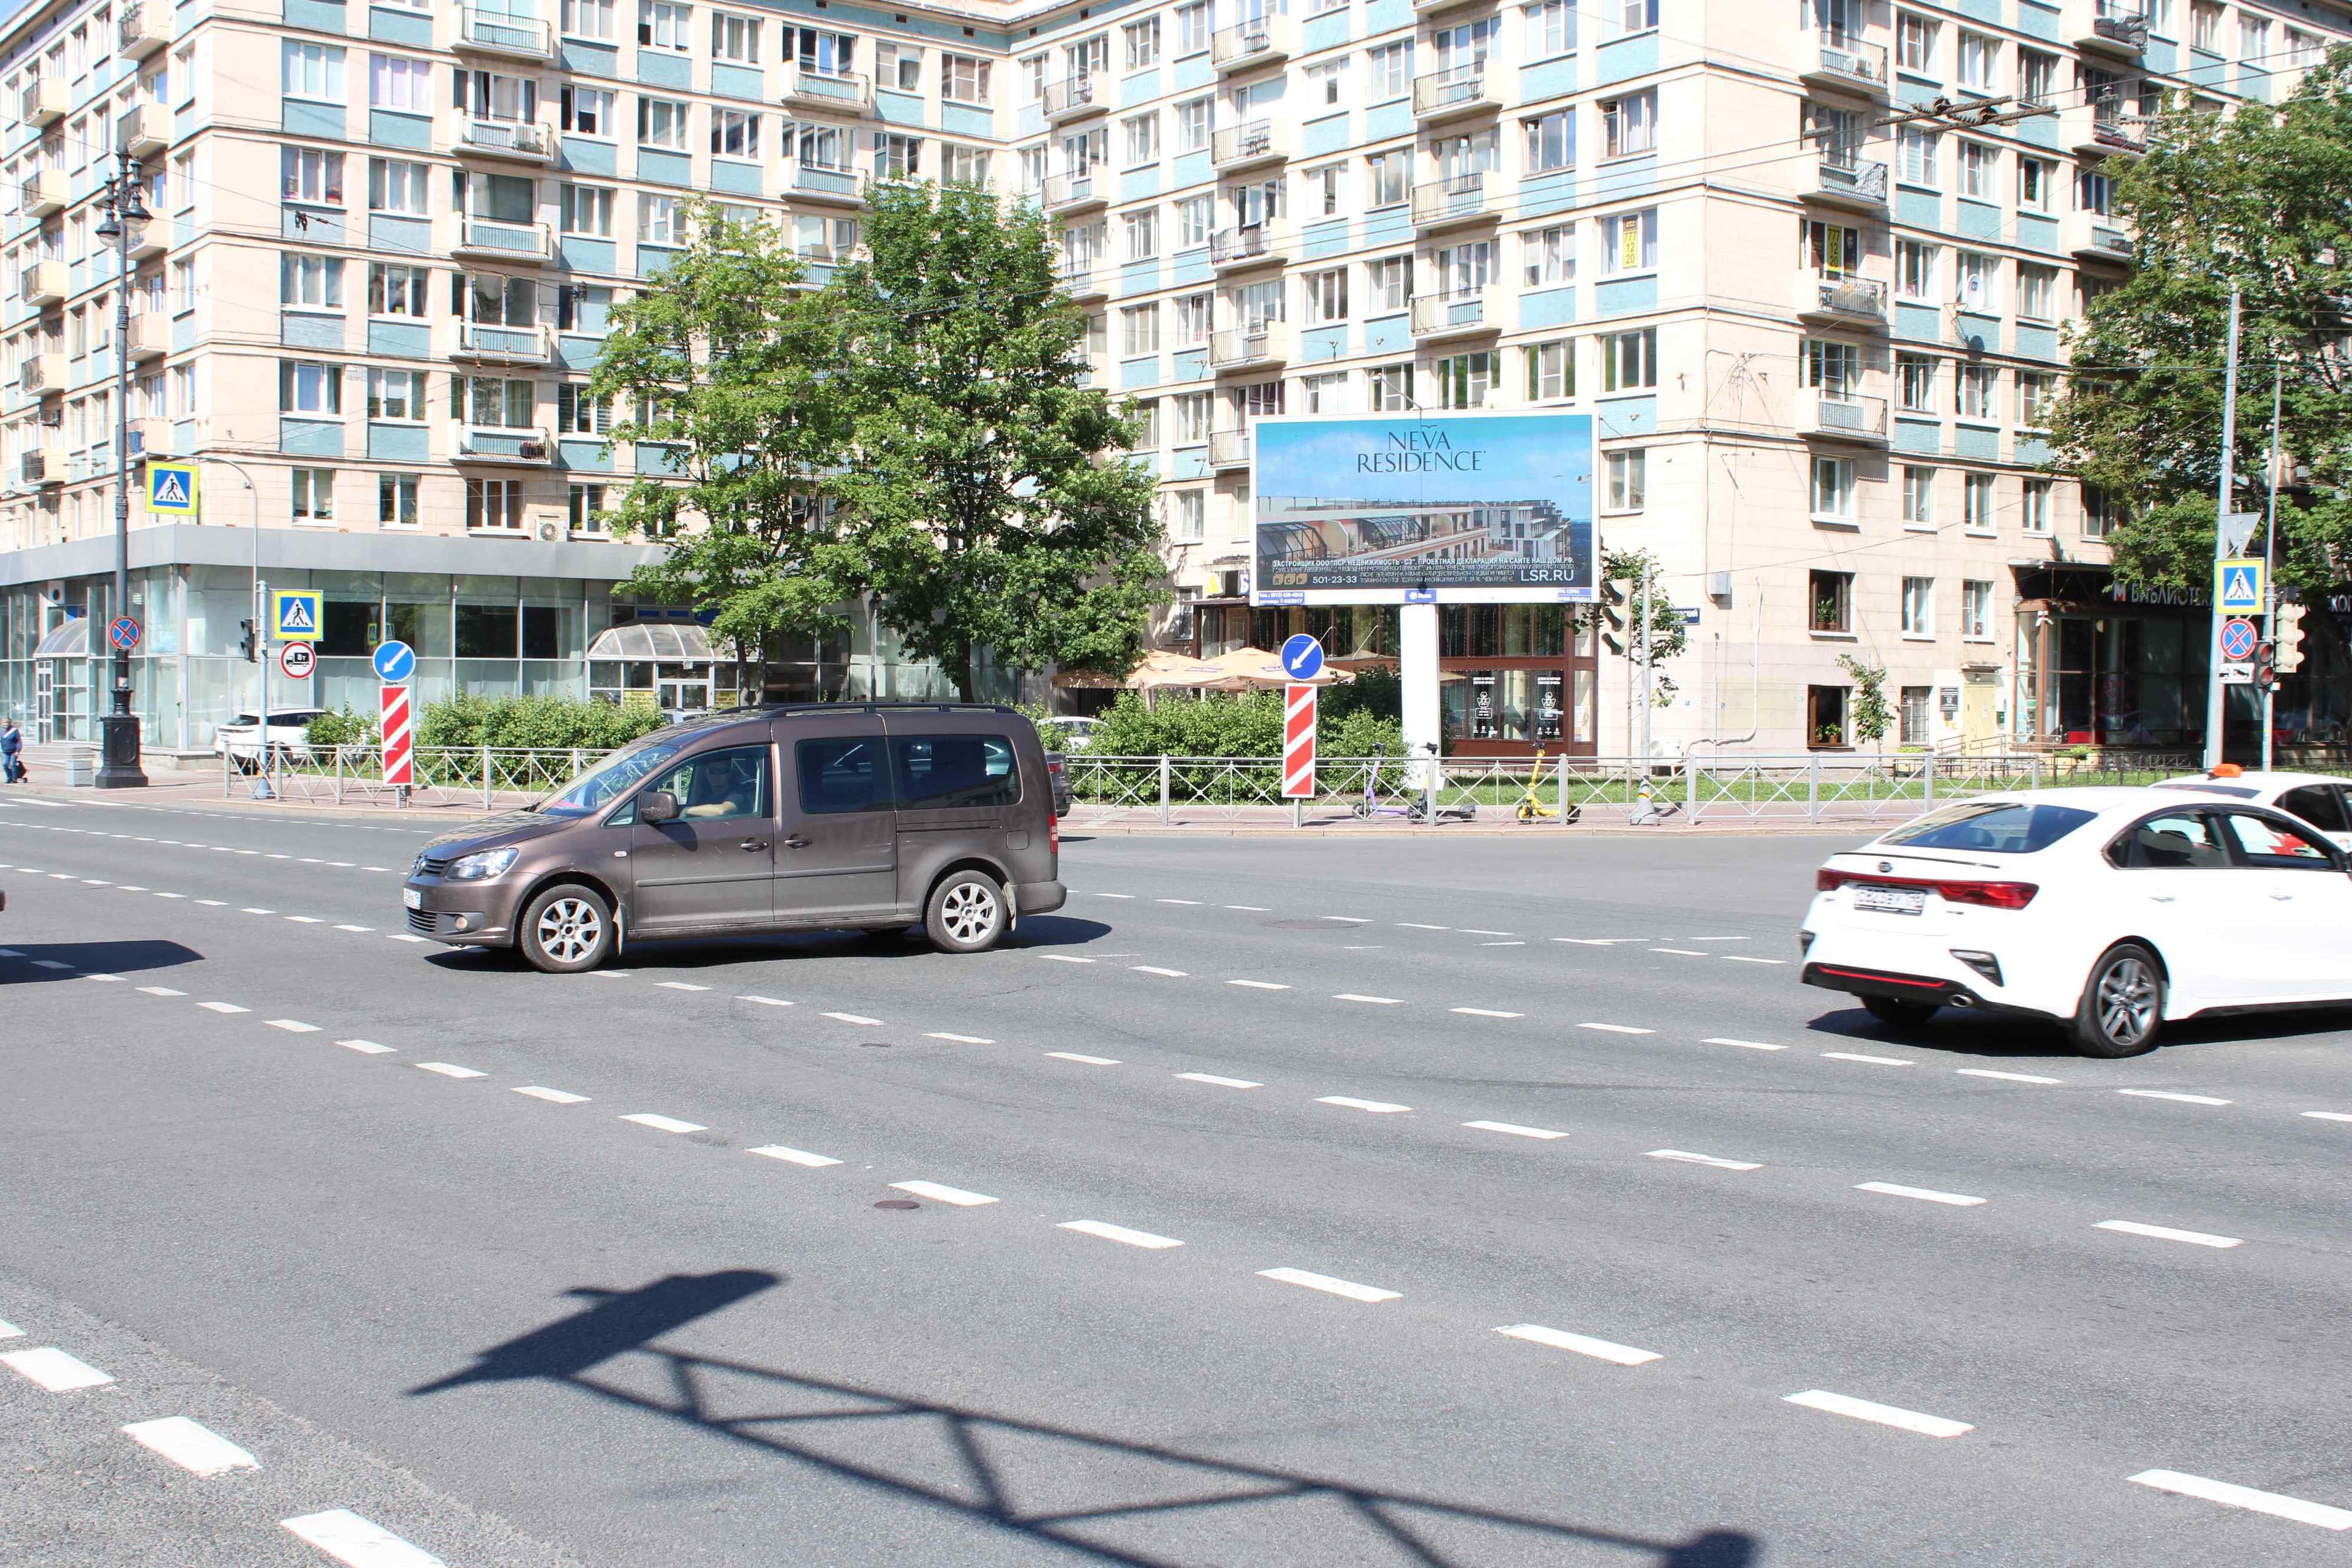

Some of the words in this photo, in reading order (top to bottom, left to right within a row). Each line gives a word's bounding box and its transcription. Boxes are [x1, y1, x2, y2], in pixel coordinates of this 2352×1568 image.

[1624, 232, 1637, 242] 777
[1828, 228, 1840, 241] 777
[1627, 242, 1635, 252] 12
[1830, 243, 1838, 254] 12
[1626, 254, 1635, 264] 20
[1830, 255, 1839, 267] 20
[1389, 431, 1451, 451] NEVA
[1357, 451, 1482, 473] RESIDENCE
[1313, 575, 1357, 584] 501-23-33
[1521, 570, 1574, 581] LSR.RU
